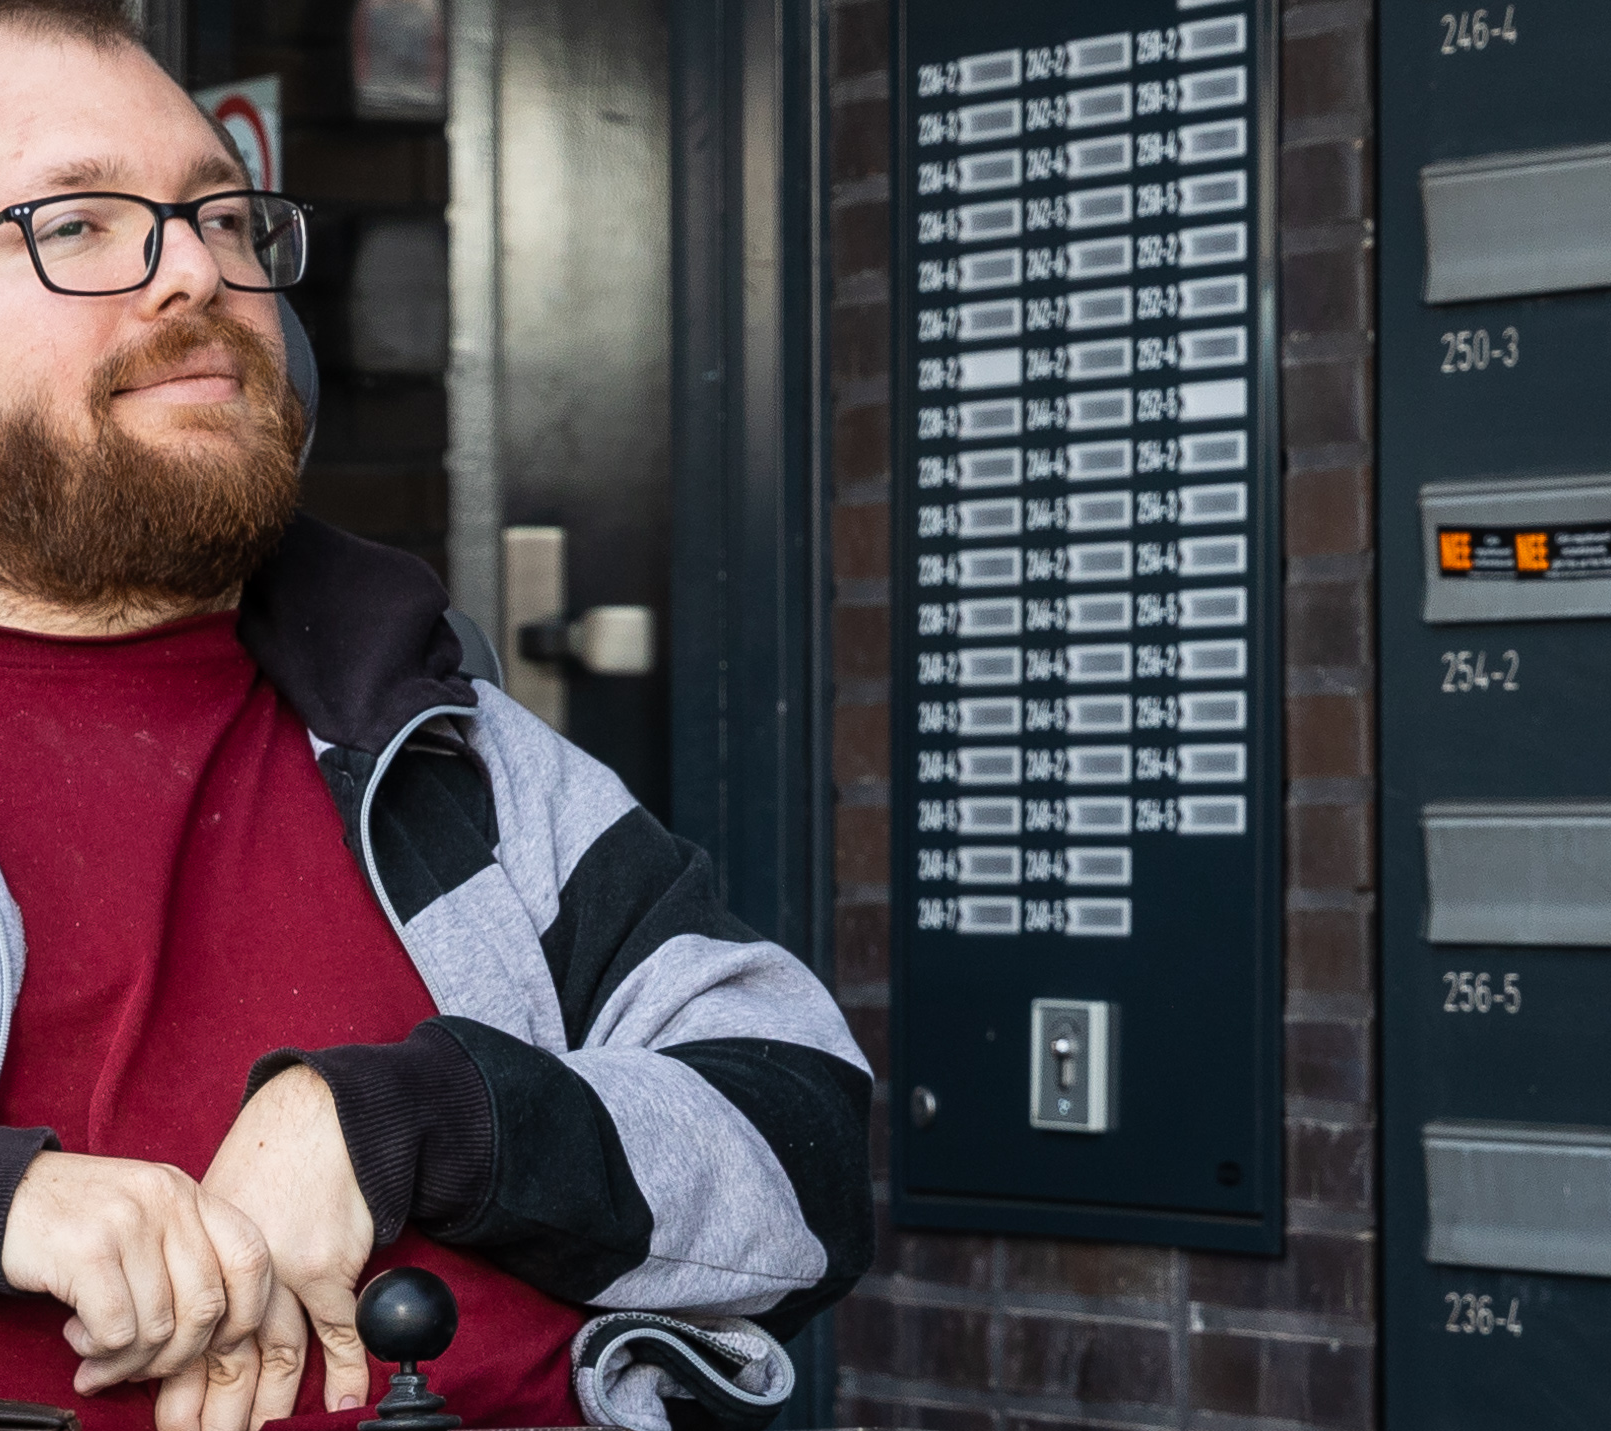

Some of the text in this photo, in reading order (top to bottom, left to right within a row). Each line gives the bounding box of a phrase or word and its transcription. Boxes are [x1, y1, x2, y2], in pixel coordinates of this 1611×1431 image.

[1440, 5, 1518, 55] 246-4
[1440, 327, 1519, 374] 250-3
[1441, 649, 1519, 693] 254-2
[1443, 971, 1521, 1014] 256-5
[1444, 1291, 1523, 1336] 236-4
